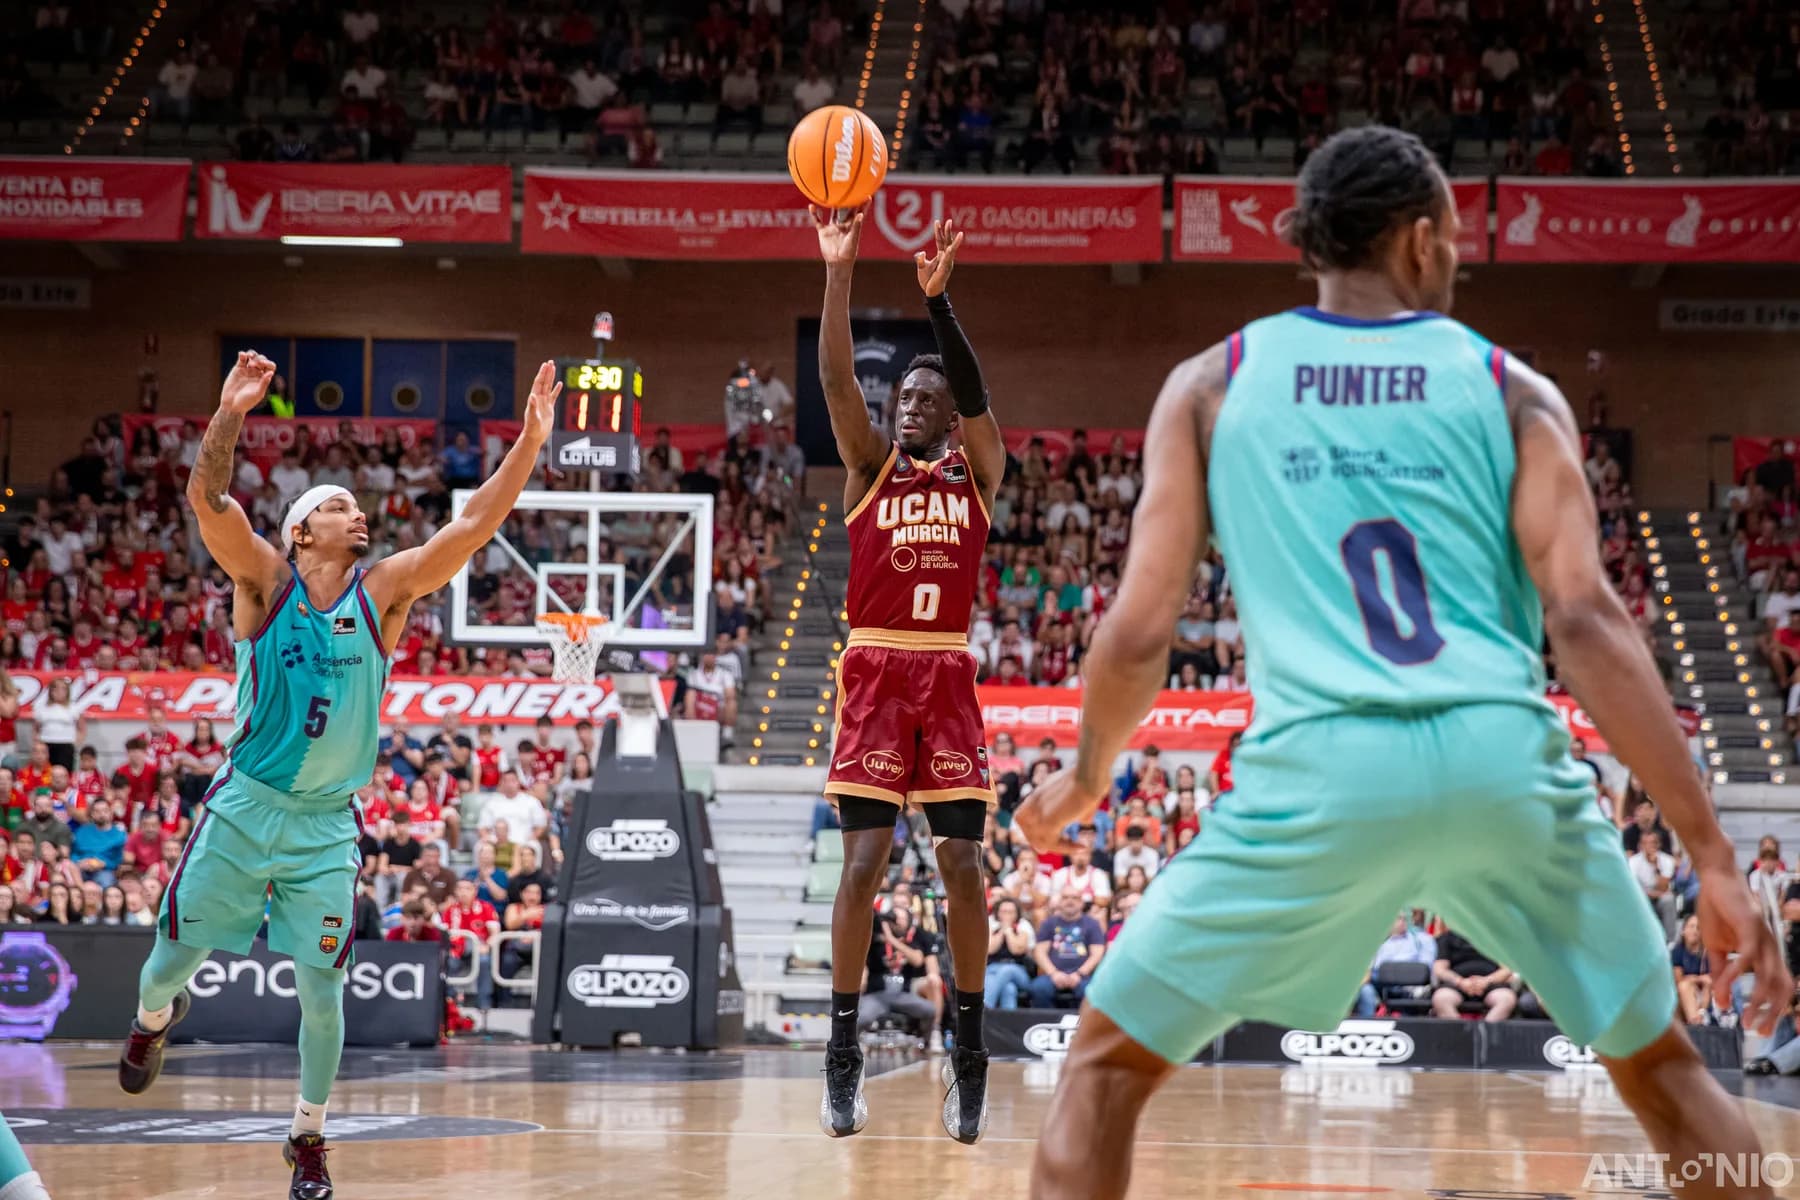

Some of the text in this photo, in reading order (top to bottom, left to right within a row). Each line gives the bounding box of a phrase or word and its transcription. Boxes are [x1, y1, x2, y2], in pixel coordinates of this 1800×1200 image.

[71, 177, 104, 197] DE
[281, 189, 501, 214] IBERIA VITAE
[578, 207, 696, 226] ESTRELLA
[982, 206, 1137, 229] GASOLINERAS
[578, 366, 622, 390] 2:30
[1294, 364, 1428, 406] PUNTER
[560, 447, 617, 467] LOTUS
[877, 491, 970, 530] UCAM
[891, 524, 961, 547] MURCIA
[912, 583, 941, 621] 0
[1341, 518, 1447, 667] 0
[304, 695, 331, 739] 5
[868, 757, 904, 774] Juver
[935, 759, 967, 772] Juver
[187, 959, 424, 1000] ensa
